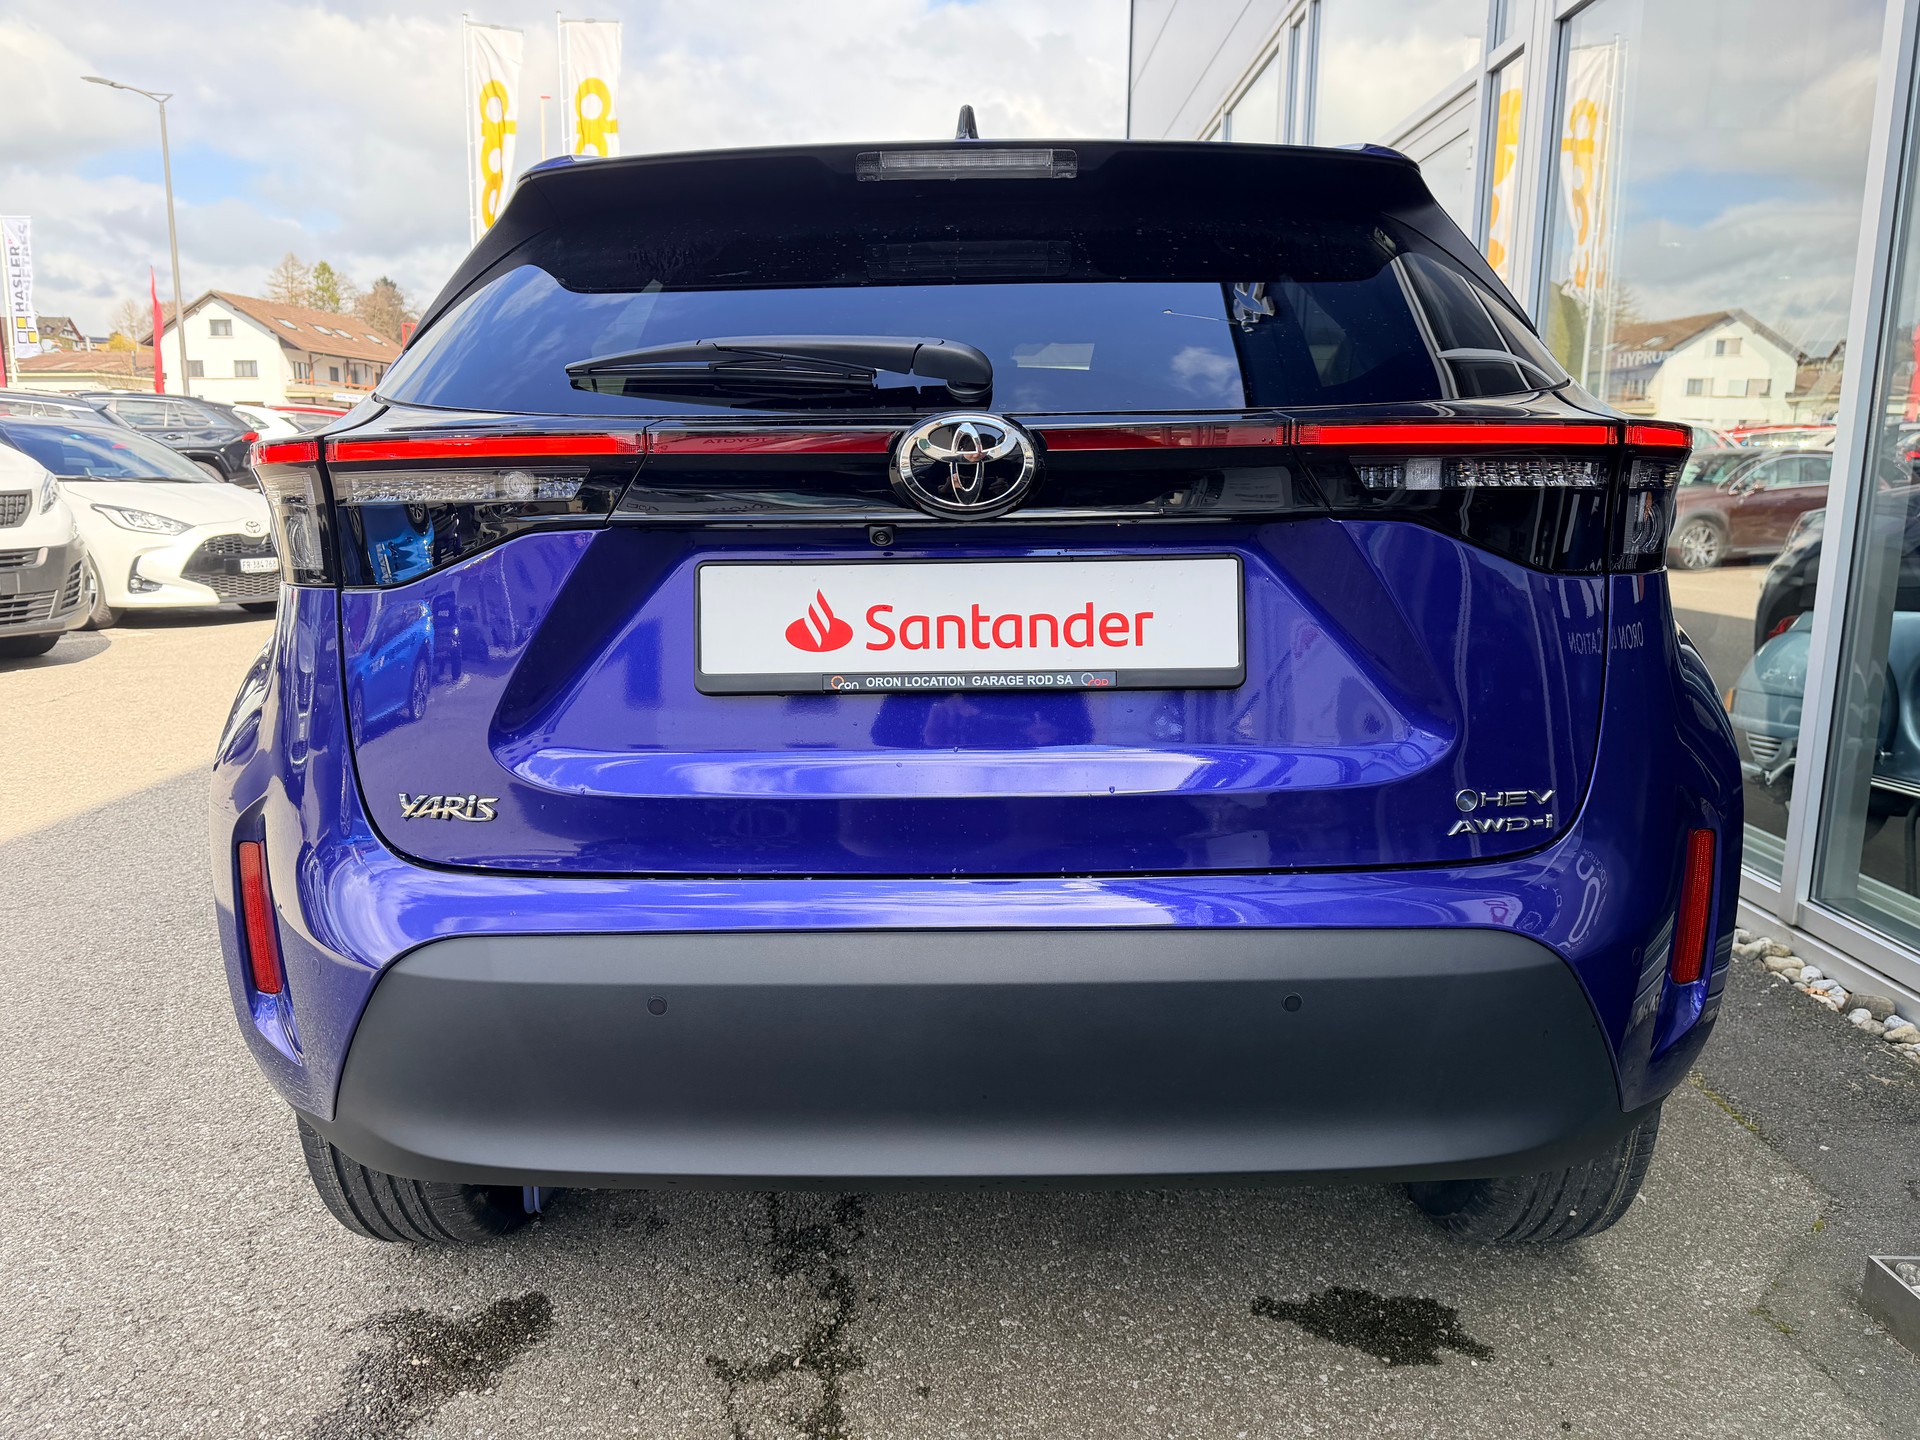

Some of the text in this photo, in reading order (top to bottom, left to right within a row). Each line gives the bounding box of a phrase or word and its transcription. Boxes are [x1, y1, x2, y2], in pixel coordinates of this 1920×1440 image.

[9, 246, 25, 312] HASLER
[865, 602, 1154, 651] Santander
[866, 676, 901, 688] ORON
[905, 676, 966, 687] LOCATION
[972, 676, 1024, 686] GARAGE
[1027, 675, 1054, 686] ROD
[1056, 675, 1074, 685] SA
[1480, 789, 1556, 808] HEV
